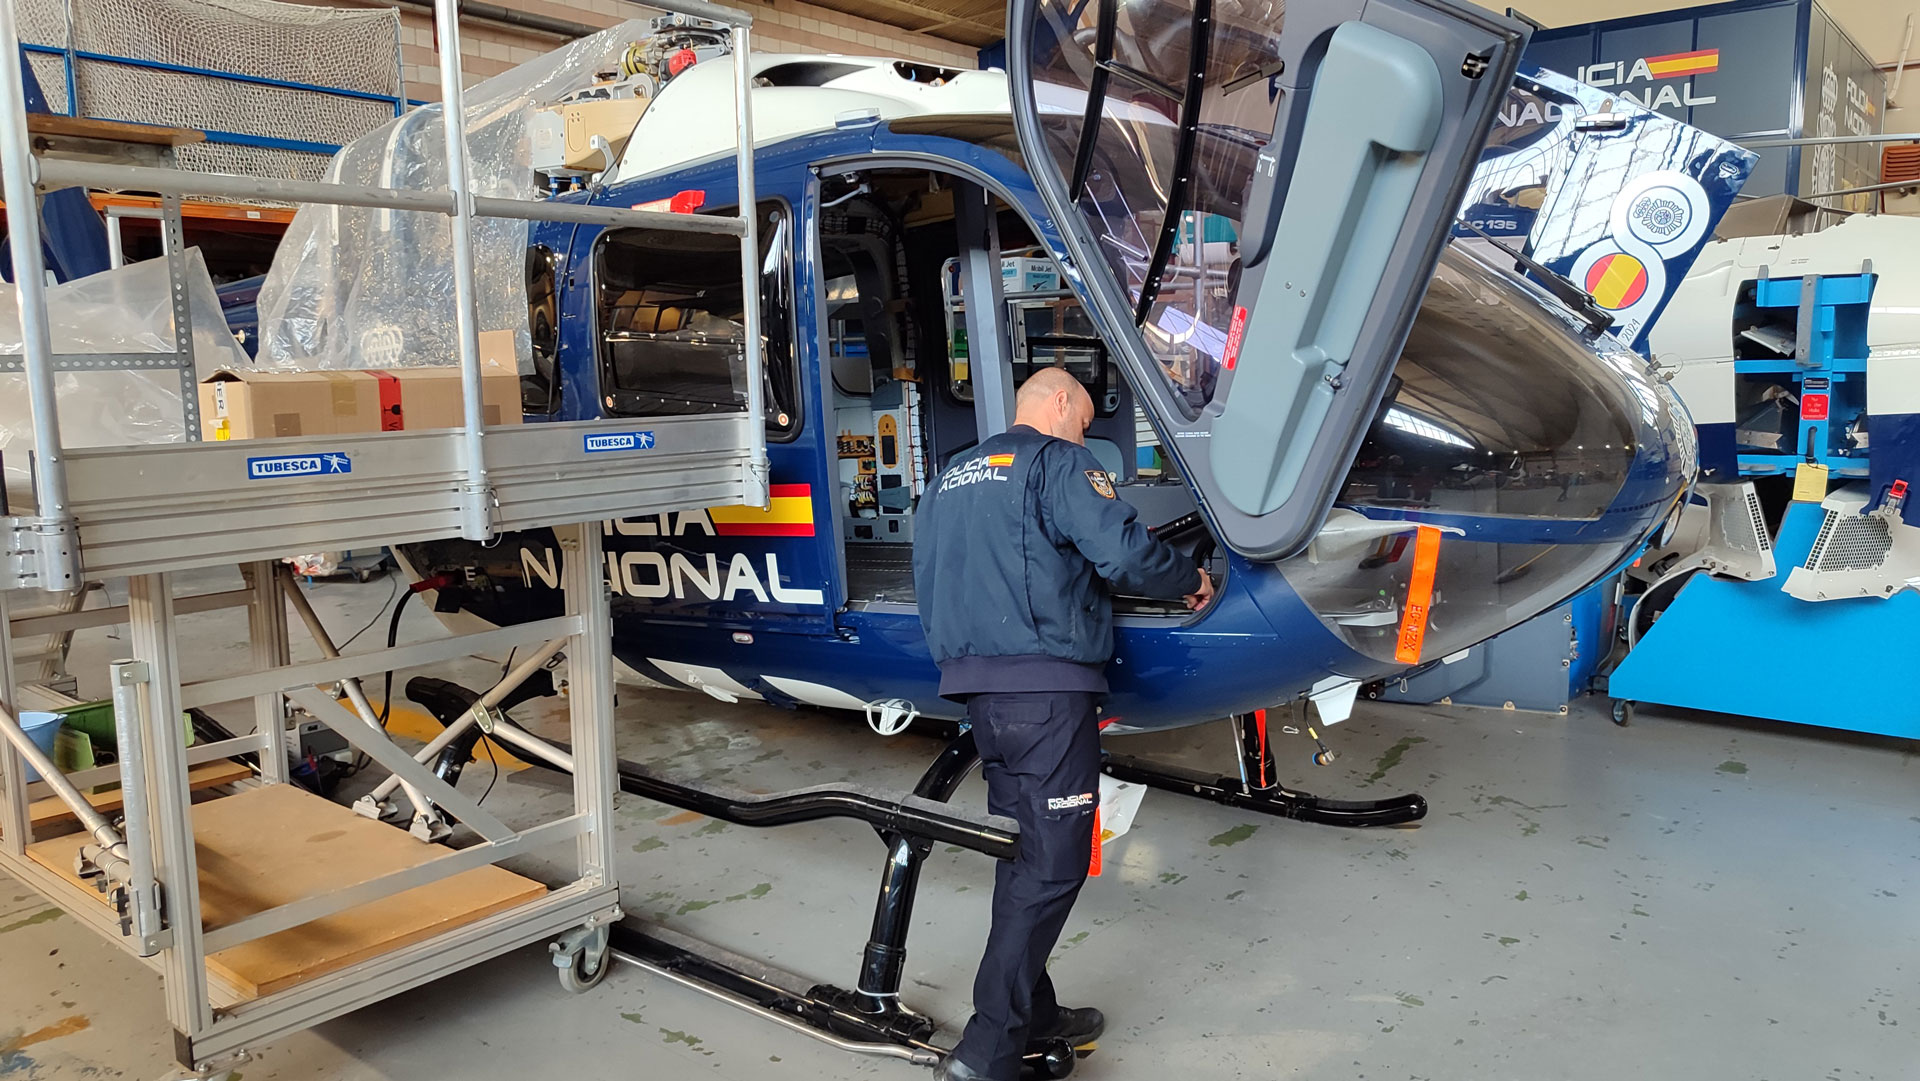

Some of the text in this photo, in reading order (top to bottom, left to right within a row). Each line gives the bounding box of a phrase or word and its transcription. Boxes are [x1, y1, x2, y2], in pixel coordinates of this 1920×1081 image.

[1486, 219, 1517, 230] 135
[590, 437, 632, 448] TUBESCA
[255, 459, 319, 474] TUBESCA
[938, 467, 1008, 494] ACIONAL
[520, 547, 823, 605] NIONAL
[1404, 604, 1422, 651] EC-NZX
